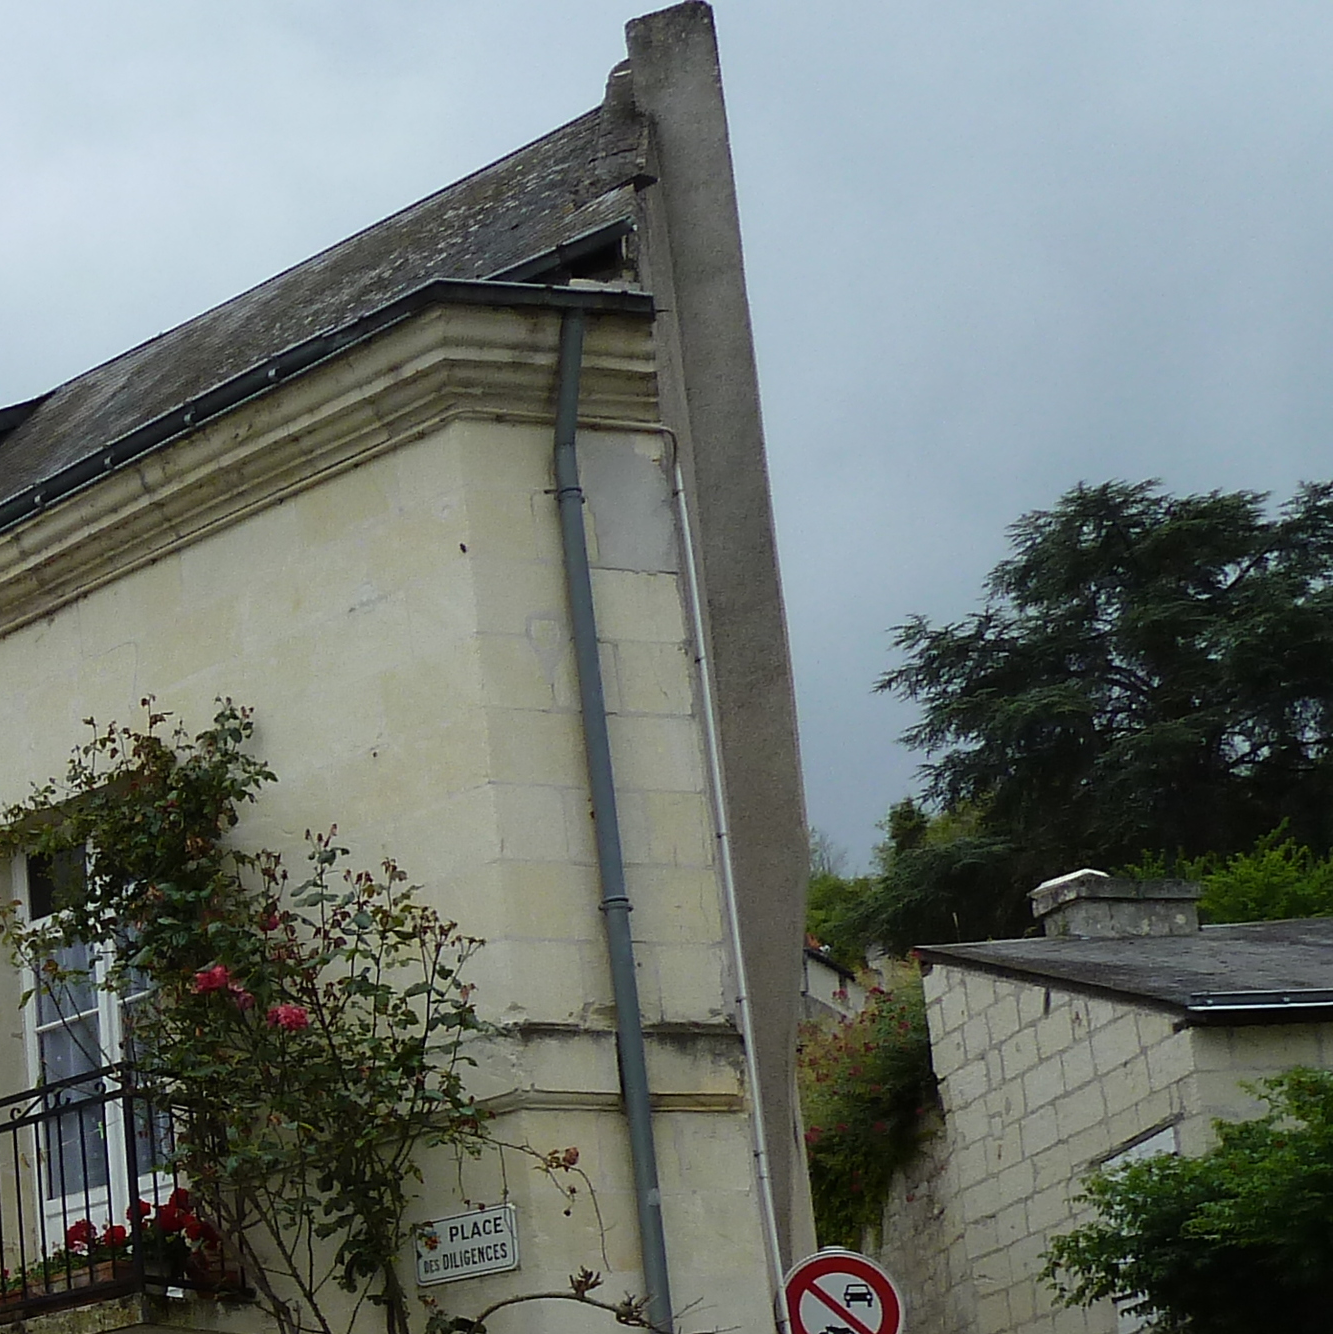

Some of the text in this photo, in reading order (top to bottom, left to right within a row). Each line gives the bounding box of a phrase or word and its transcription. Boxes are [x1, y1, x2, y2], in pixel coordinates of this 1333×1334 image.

[448, 1216, 504, 1242] PLACE
[423, 1242, 508, 1275] DES DILIGENCES
